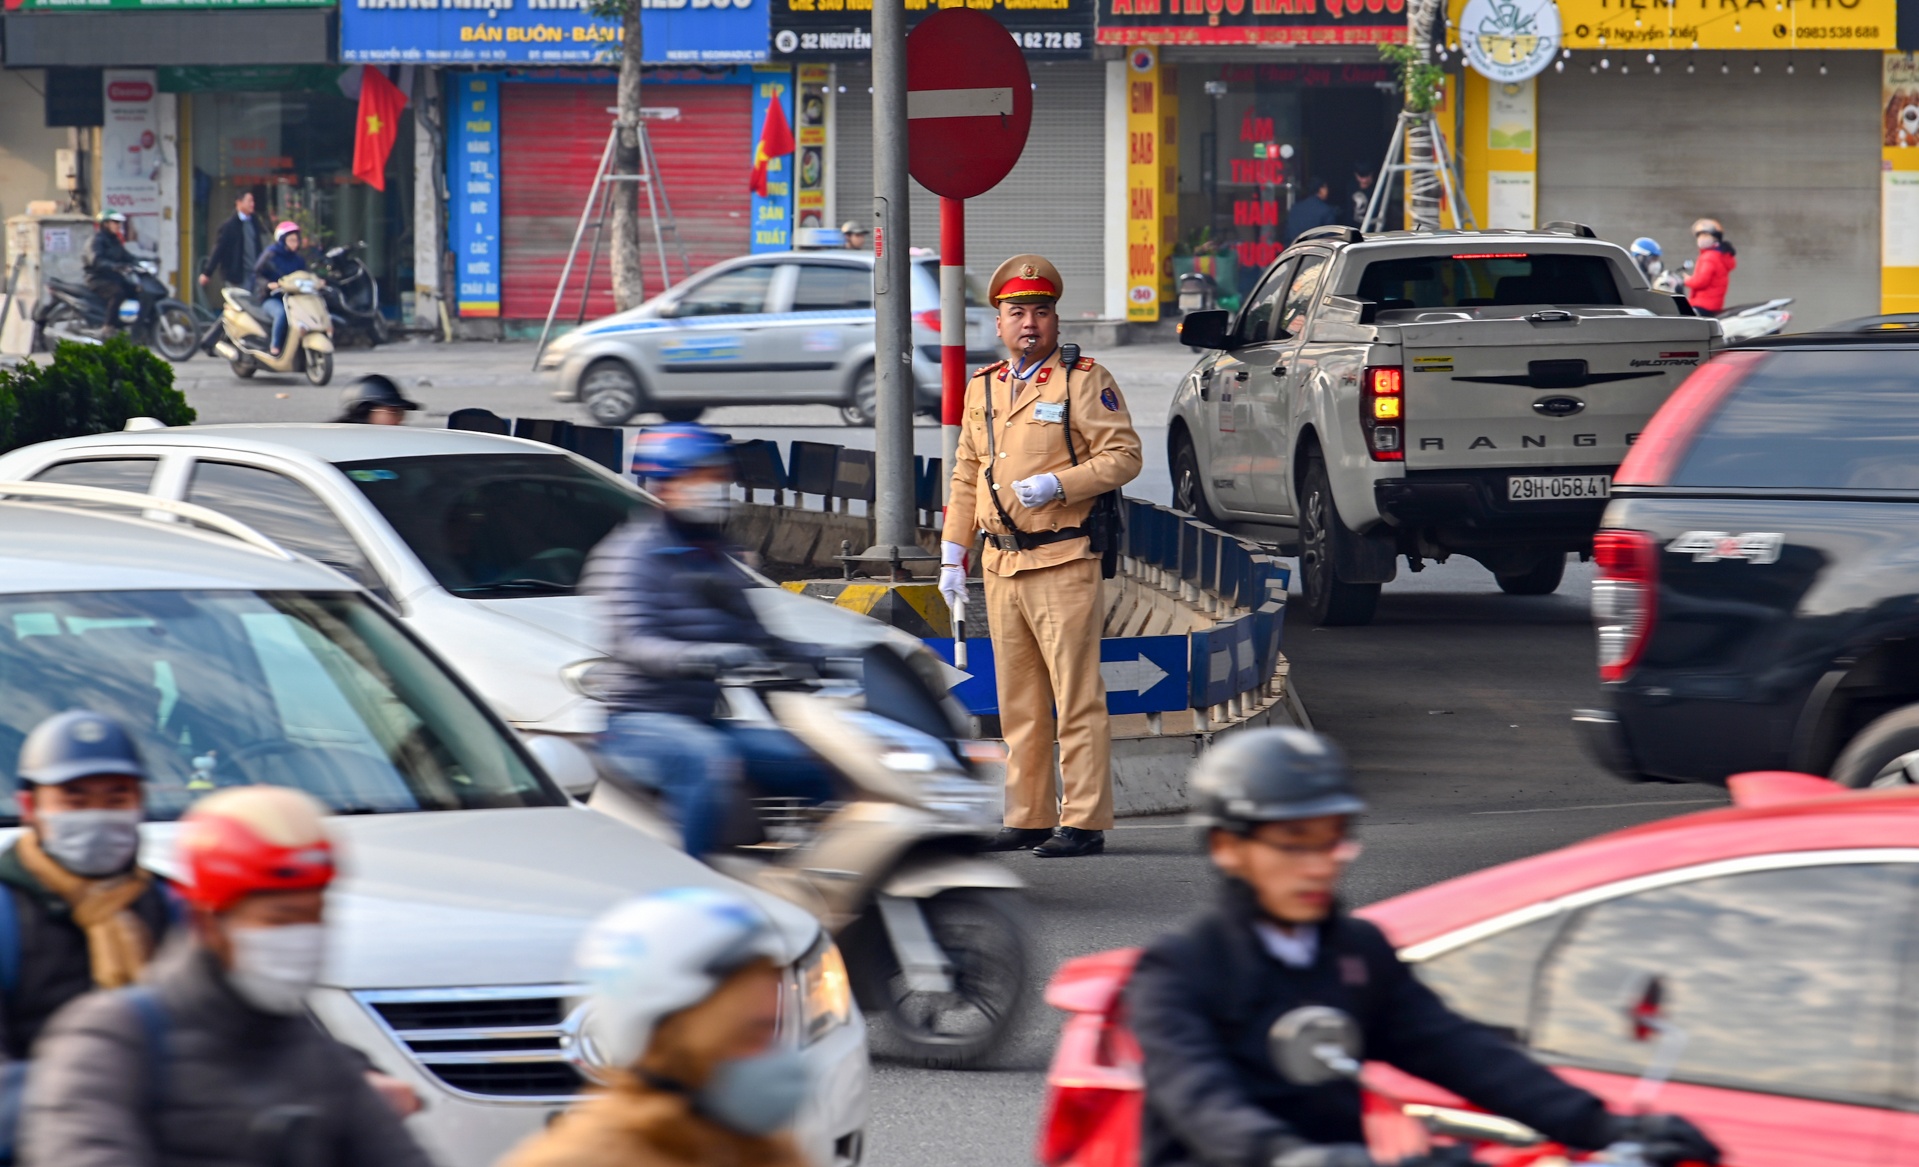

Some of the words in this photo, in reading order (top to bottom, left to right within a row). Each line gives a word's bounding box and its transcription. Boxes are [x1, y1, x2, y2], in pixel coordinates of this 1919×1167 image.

[461, 23, 503, 42] BÁN
[507, 24, 563, 42] BUÔN
[572, 23, 614, 42] BÁN
[801, 32, 818, 49] 32
[820, 27, 872, 49] NGUYỄN
[1024, 32, 1042, 49] 62
[1044, 32, 1062, 49] 72
[1511, 476, 1607, 499] 29H-058.41
